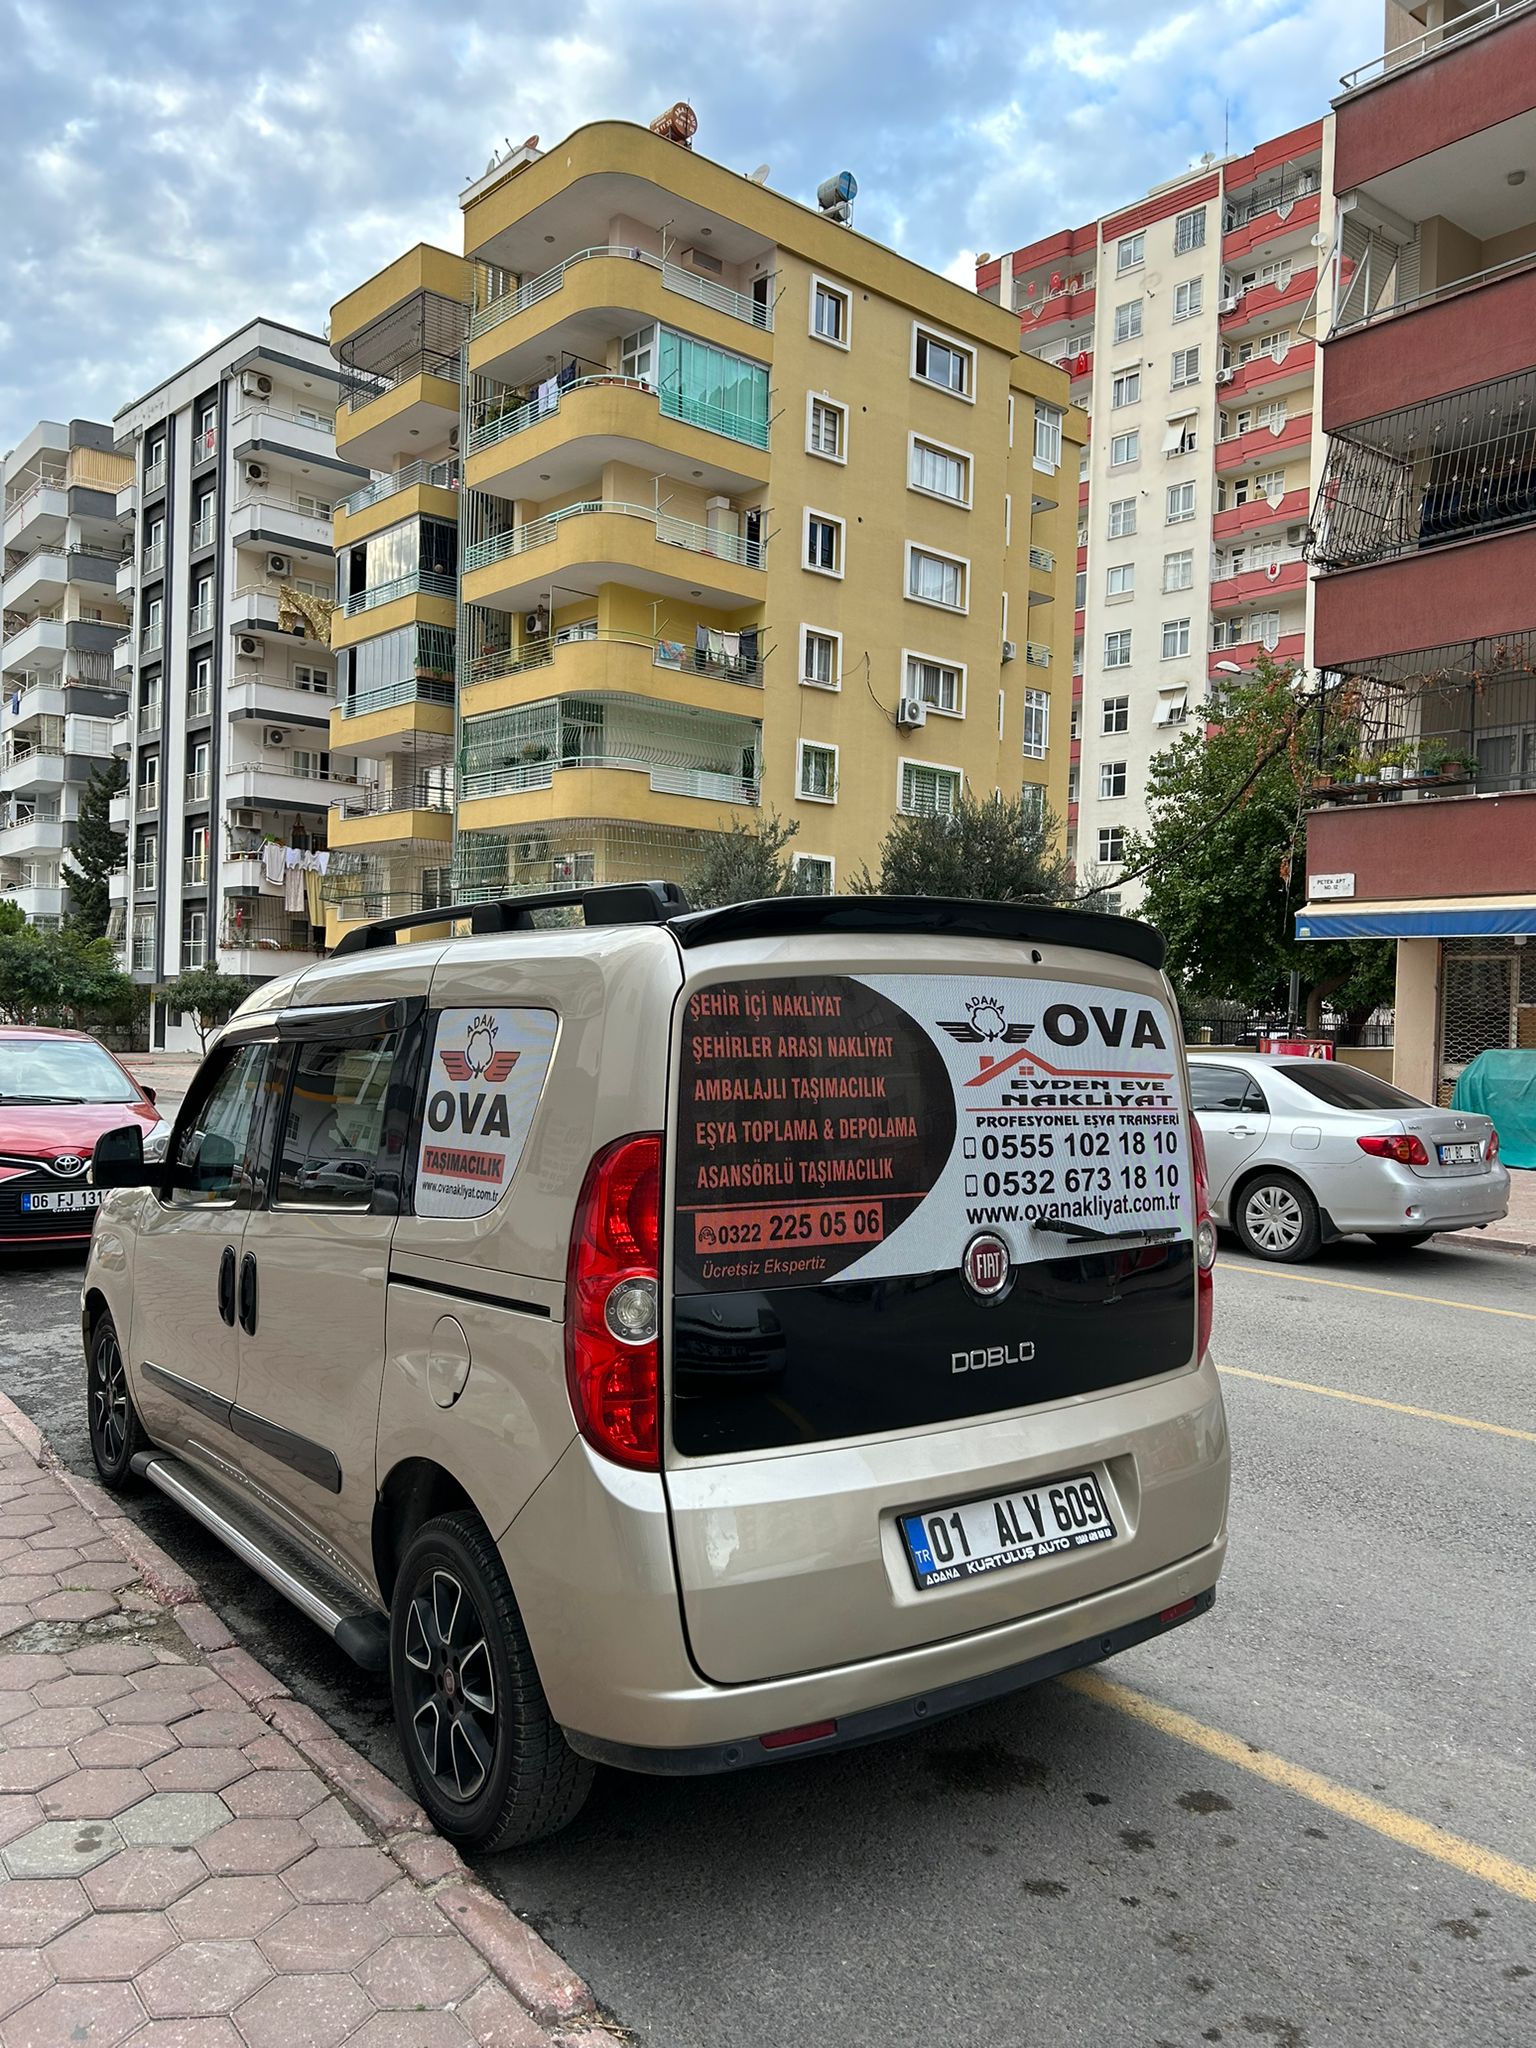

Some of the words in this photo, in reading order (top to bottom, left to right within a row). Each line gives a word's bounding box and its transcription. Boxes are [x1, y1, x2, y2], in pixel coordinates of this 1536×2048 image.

[691, 989, 739, 1022] ŞEHİR
[745, 990, 768, 1021] İÇİ
[773, 991, 842, 1017] NAKLİYAT
[965, 996, 1005, 1016] ADANA
[467, 1014, 499, 1039] ADANA
[1042, 1003, 1167, 1050] OVA
[692, 1032, 772, 1064] ŞEHİRLER
[778, 1036, 823, 1057] ARASI
[828, 1032, 893, 1057] NAKLİYAT
[694, 1078, 787, 1102] AMBALAJLI
[791, 1077, 886, 1104] TAŞIMACILIK
[1001, 1091, 1173, 1107] NAKLİYAT
[1010, 1080, 1110, 1090] EVDEN
[1120, 1081, 1165, 1091] EVE
[428, 1091, 511, 1138] OVA
[976, 1115, 1080, 1129] PROFESYONEL
[1084, 1115, 1115, 1129] EŞYA
[1119, 1112, 1180, 1126] TRANSFERİ
[696, 1122, 736, 1151] EŞYA
[742, 1119, 818, 1143] TOPLAMA
[824, 1119, 834, 1139] &
[840, 1116, 917, 1139] DEPOLAMA
[982, 1133, 1054, 1160] 0555
[1064, 1132, 1110, 1157] 102
[1119, 1131, 1146, 1155] 18
[1154, 1131, 1177, 1154] 10
[426, 1151, 502, 1180] TAŞIMACILIK
[698, 1157, 794, 1188] ASANSÖRLÜ
[799, 1158, 894, 1188] TAŞIMACILIK
[421, 1181, 499, 1202] www.ovanakliyat.com.tr
[983, 1169, 1056, 1198] 0532
[1065, 1167, 1112, 1192] 673
[1120, 1165, 1146, 1189] 18
[1155, 1164, 1178, 1188] 10
[32, 1195, 49, 1209] 06
[57, 1193, 74, 1207] FJ
[966, 1192, 1181, 1224] www.ovanakliyat.com.tr
[718, 1223, 762, 1245] 0322
[769, 1214, 812, 1241] 225
[820, 1212, 847, 1238] 05
[853, 1209, 881, 1235] 06
[702, 1258, 759, 1280] Ücretsiz
[764, 1256, 826, 1278] Ekspertiz
[976, 1252, 1000, 1280] FIAT
[951, 1341, 1035, 1374] DOBLO
[927, 1512, 971, 1562] 01
[993, 1494, 1045, 1548] ALV
[1048, 1482, 1103, 1531] 609
[915, 1548, 931, 1564] TR
[926, 1567, 961, 1586] ADANA
[966, 1547, 1036, 1574] KURTULUŞ
[1037, 1538, 1071, 1556] AUTO
